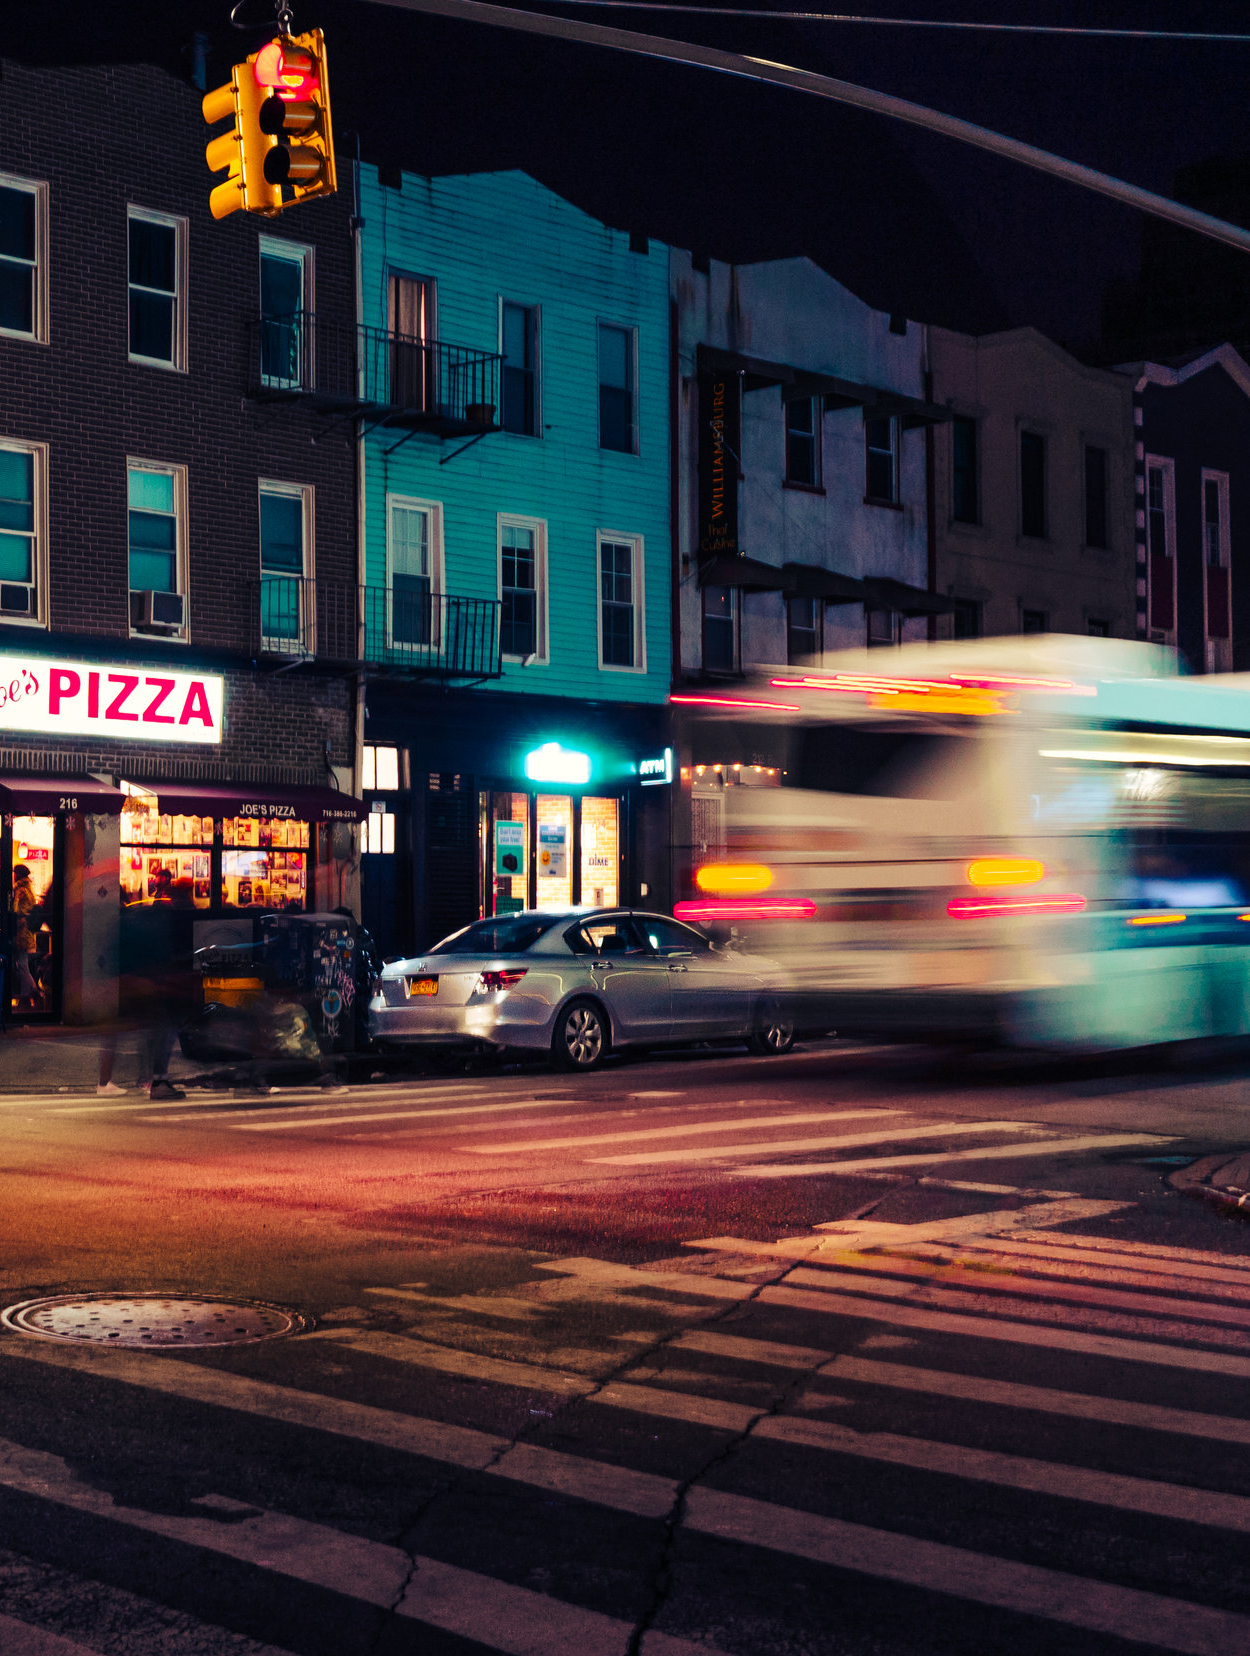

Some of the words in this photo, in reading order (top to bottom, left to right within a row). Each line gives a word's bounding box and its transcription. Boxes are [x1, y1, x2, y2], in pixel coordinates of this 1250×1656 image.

[48, 668, 215, 728] PIZZA
[640, 759, 665, 775] ATM
[59, 798, 78, 809] 216
[239, 804, 268, 816] JOE'S
[269, 805, 296, 817] PIZZA
[28, 851, 48, 859] PIZZA
